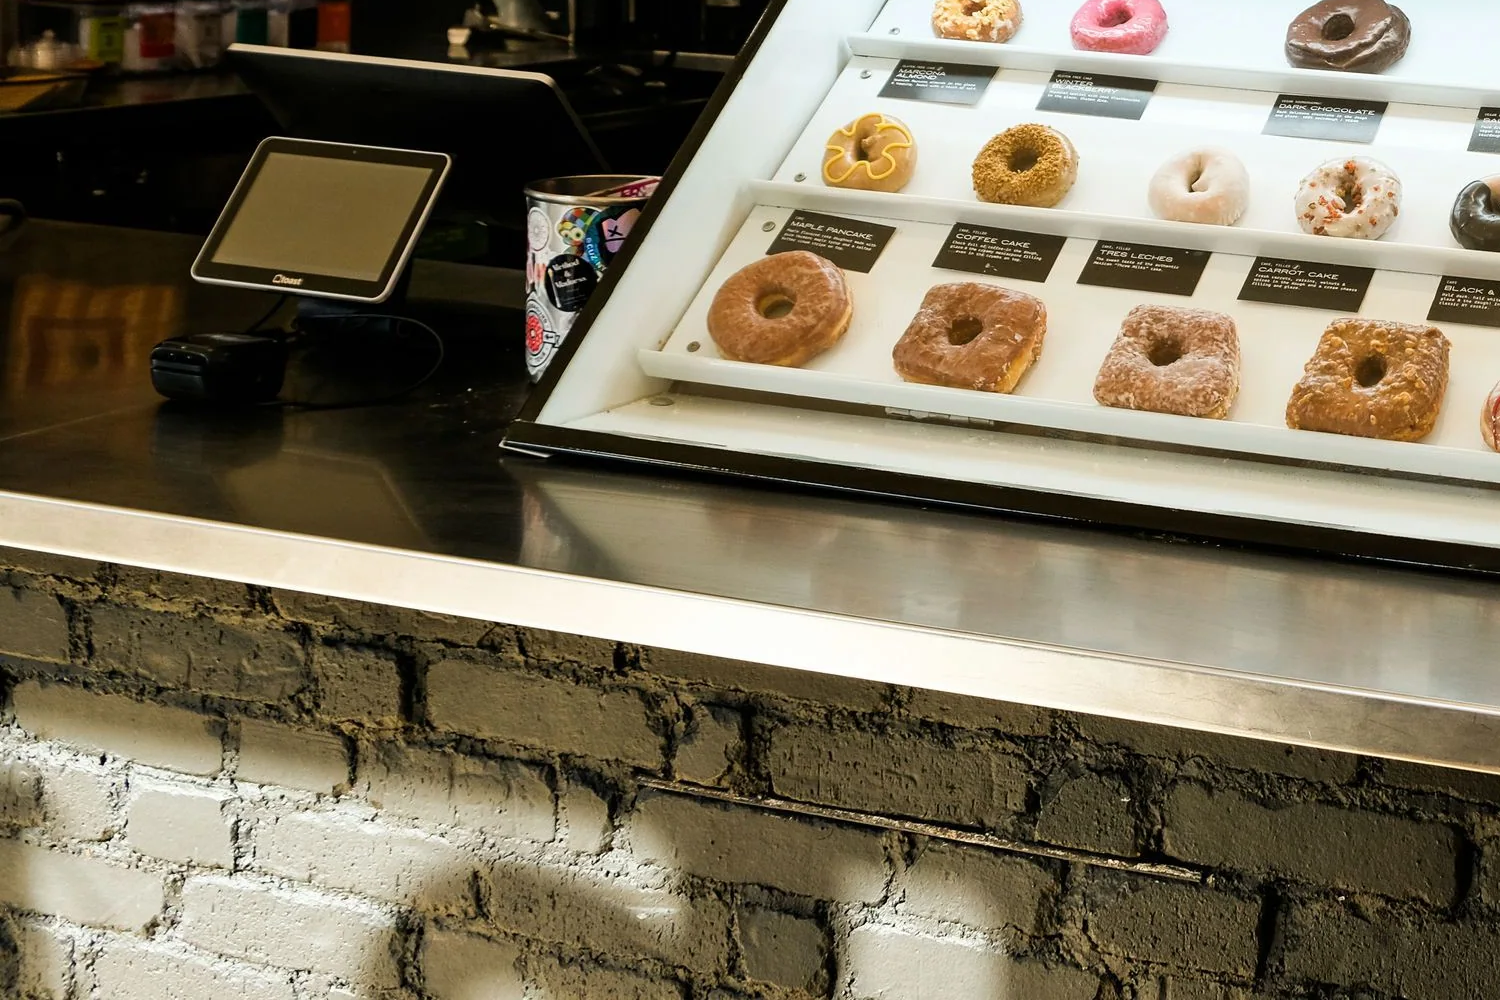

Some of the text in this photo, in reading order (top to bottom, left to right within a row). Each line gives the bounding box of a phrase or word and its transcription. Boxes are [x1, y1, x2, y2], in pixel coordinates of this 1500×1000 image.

[1278, 103, 1375, 116] DARK CHOCOLATE
[790, 220, 824, 231] MAPLE
[826, 226, 873, 241] PANCAKE
[955, 233, 1031, 249] COFFEE CAKE
[1100, 250, 1174, 262] TRES LECHES
[1258, 267, 1339, 280] CARROT CAKE
[1444, 285, 1484, 294] BLACK
